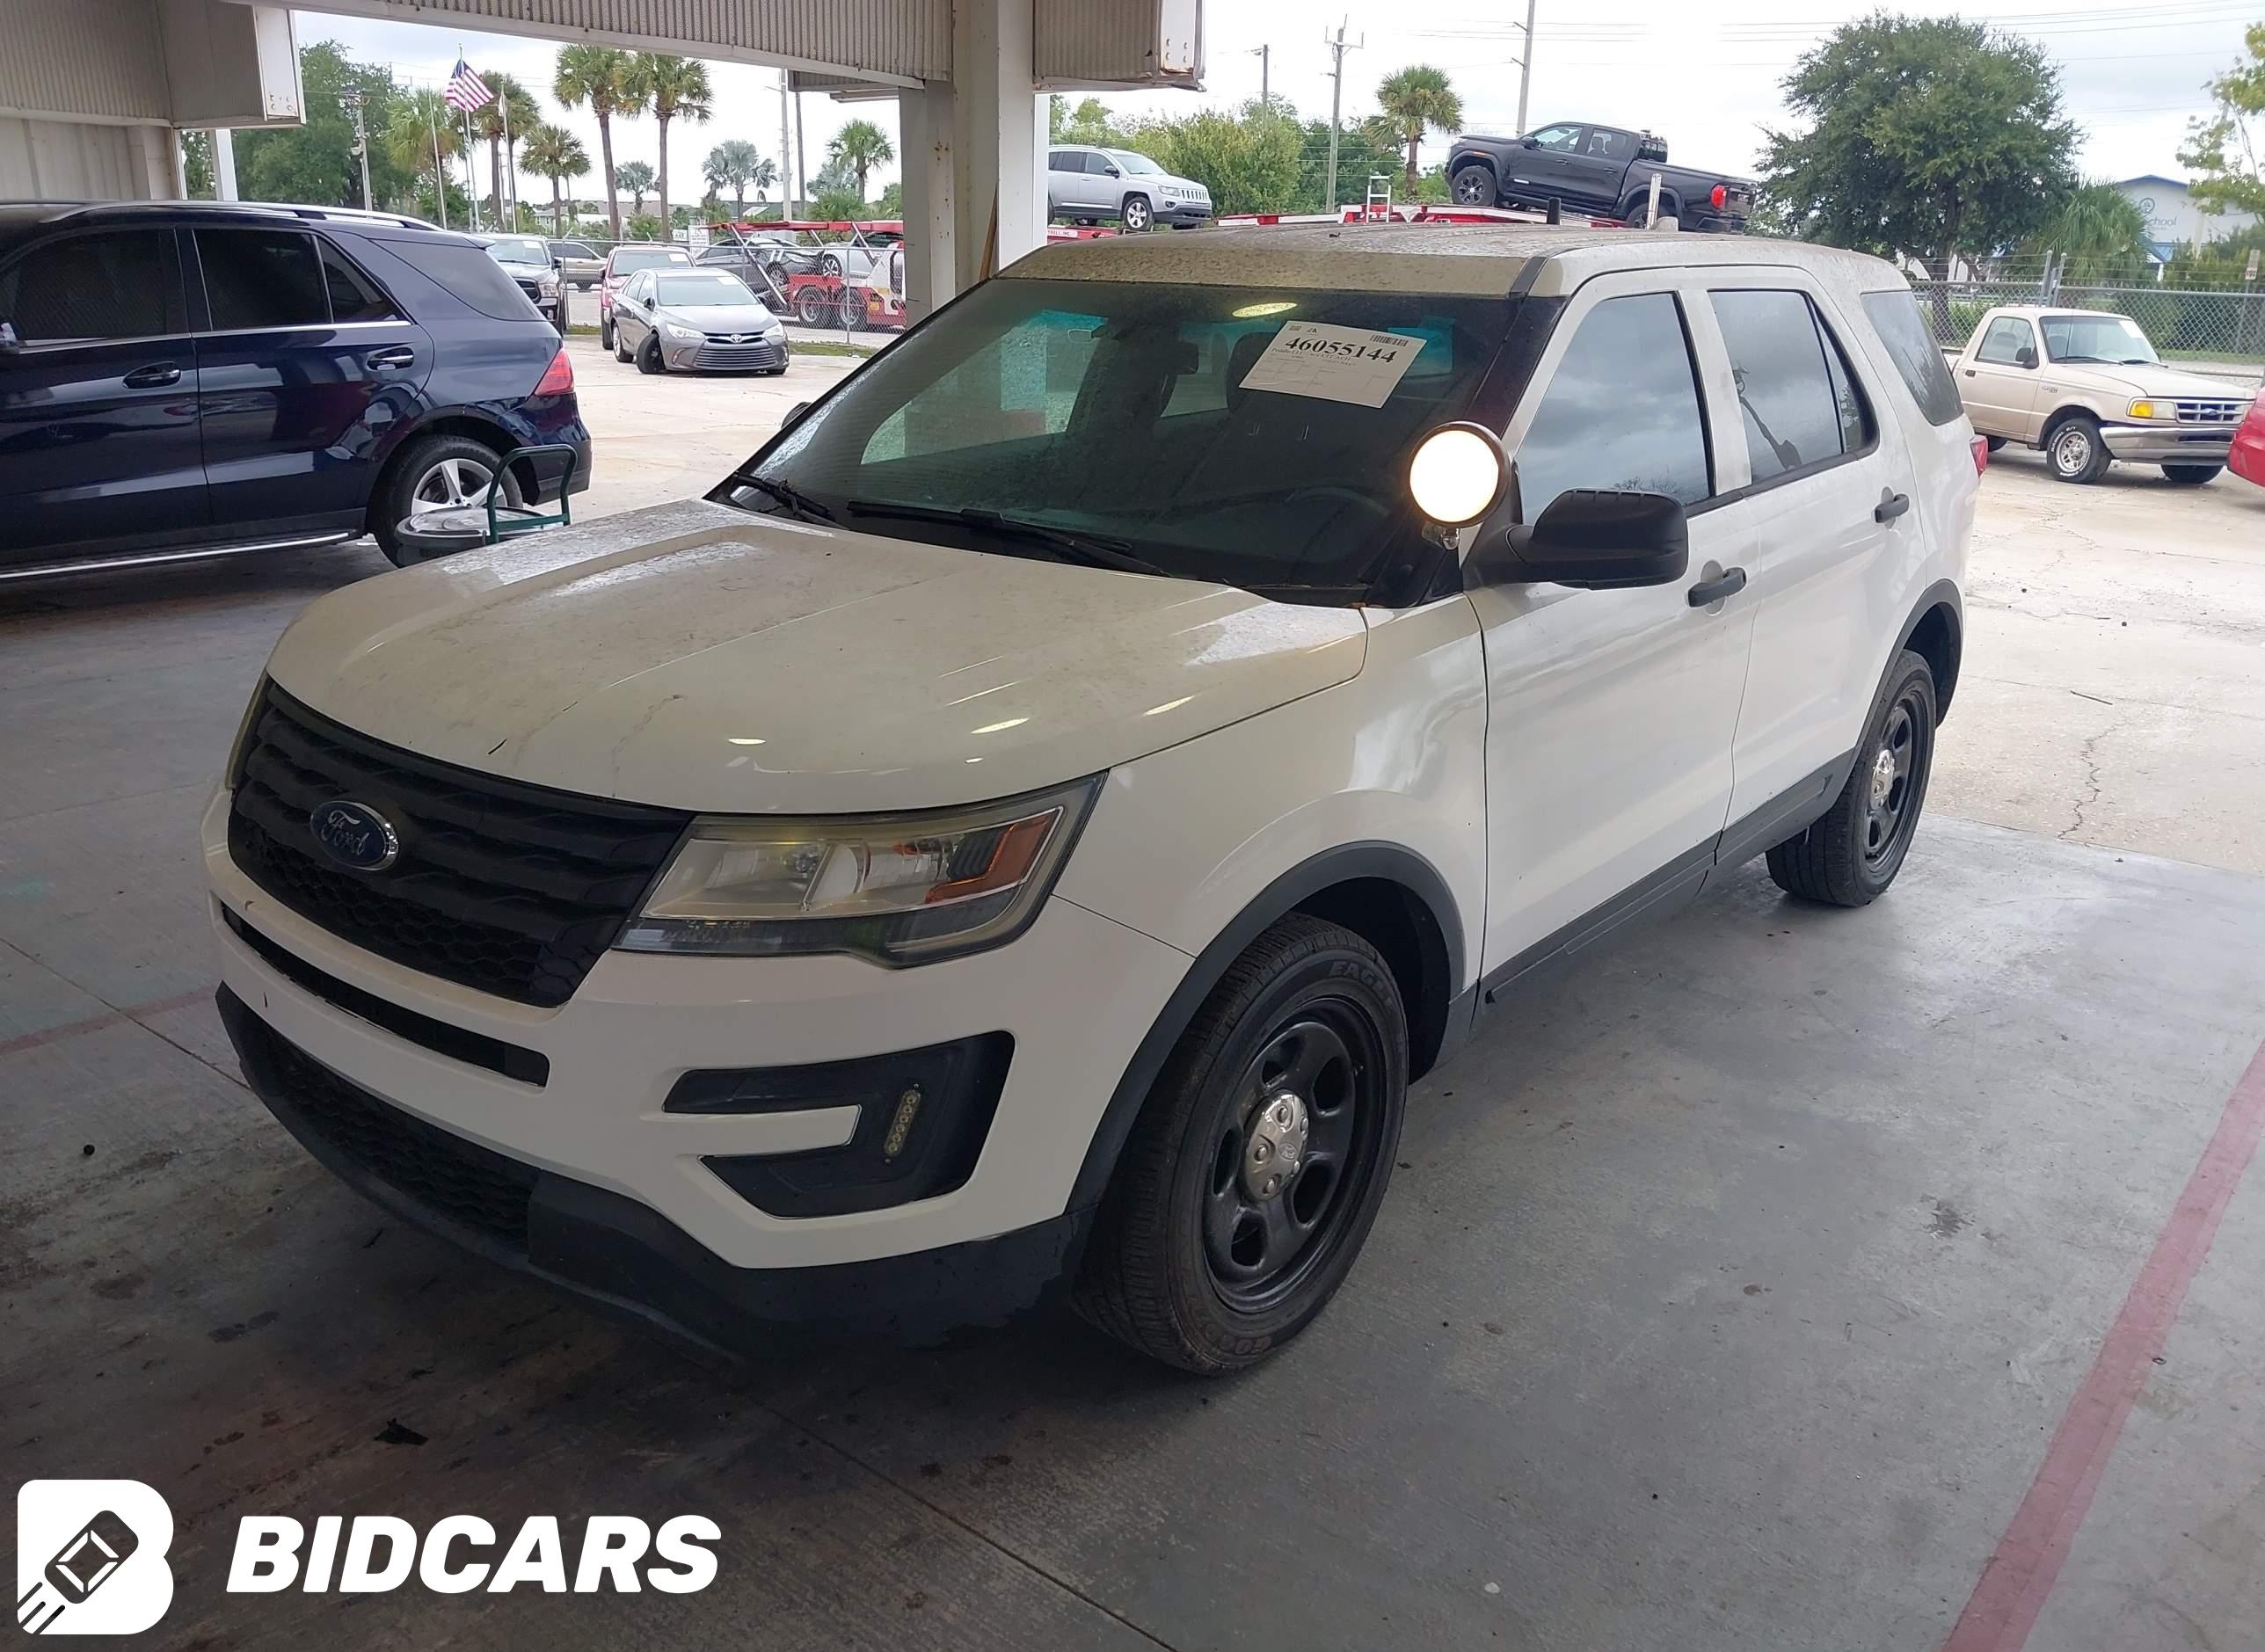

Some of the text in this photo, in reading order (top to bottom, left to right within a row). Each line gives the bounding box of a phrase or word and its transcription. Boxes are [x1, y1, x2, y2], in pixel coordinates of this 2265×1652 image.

[1284, 337, 1397, 363] 46055144
[320, 809, 370, 856] Ford
[1329, 959, 1395, 1015] EAGLE
